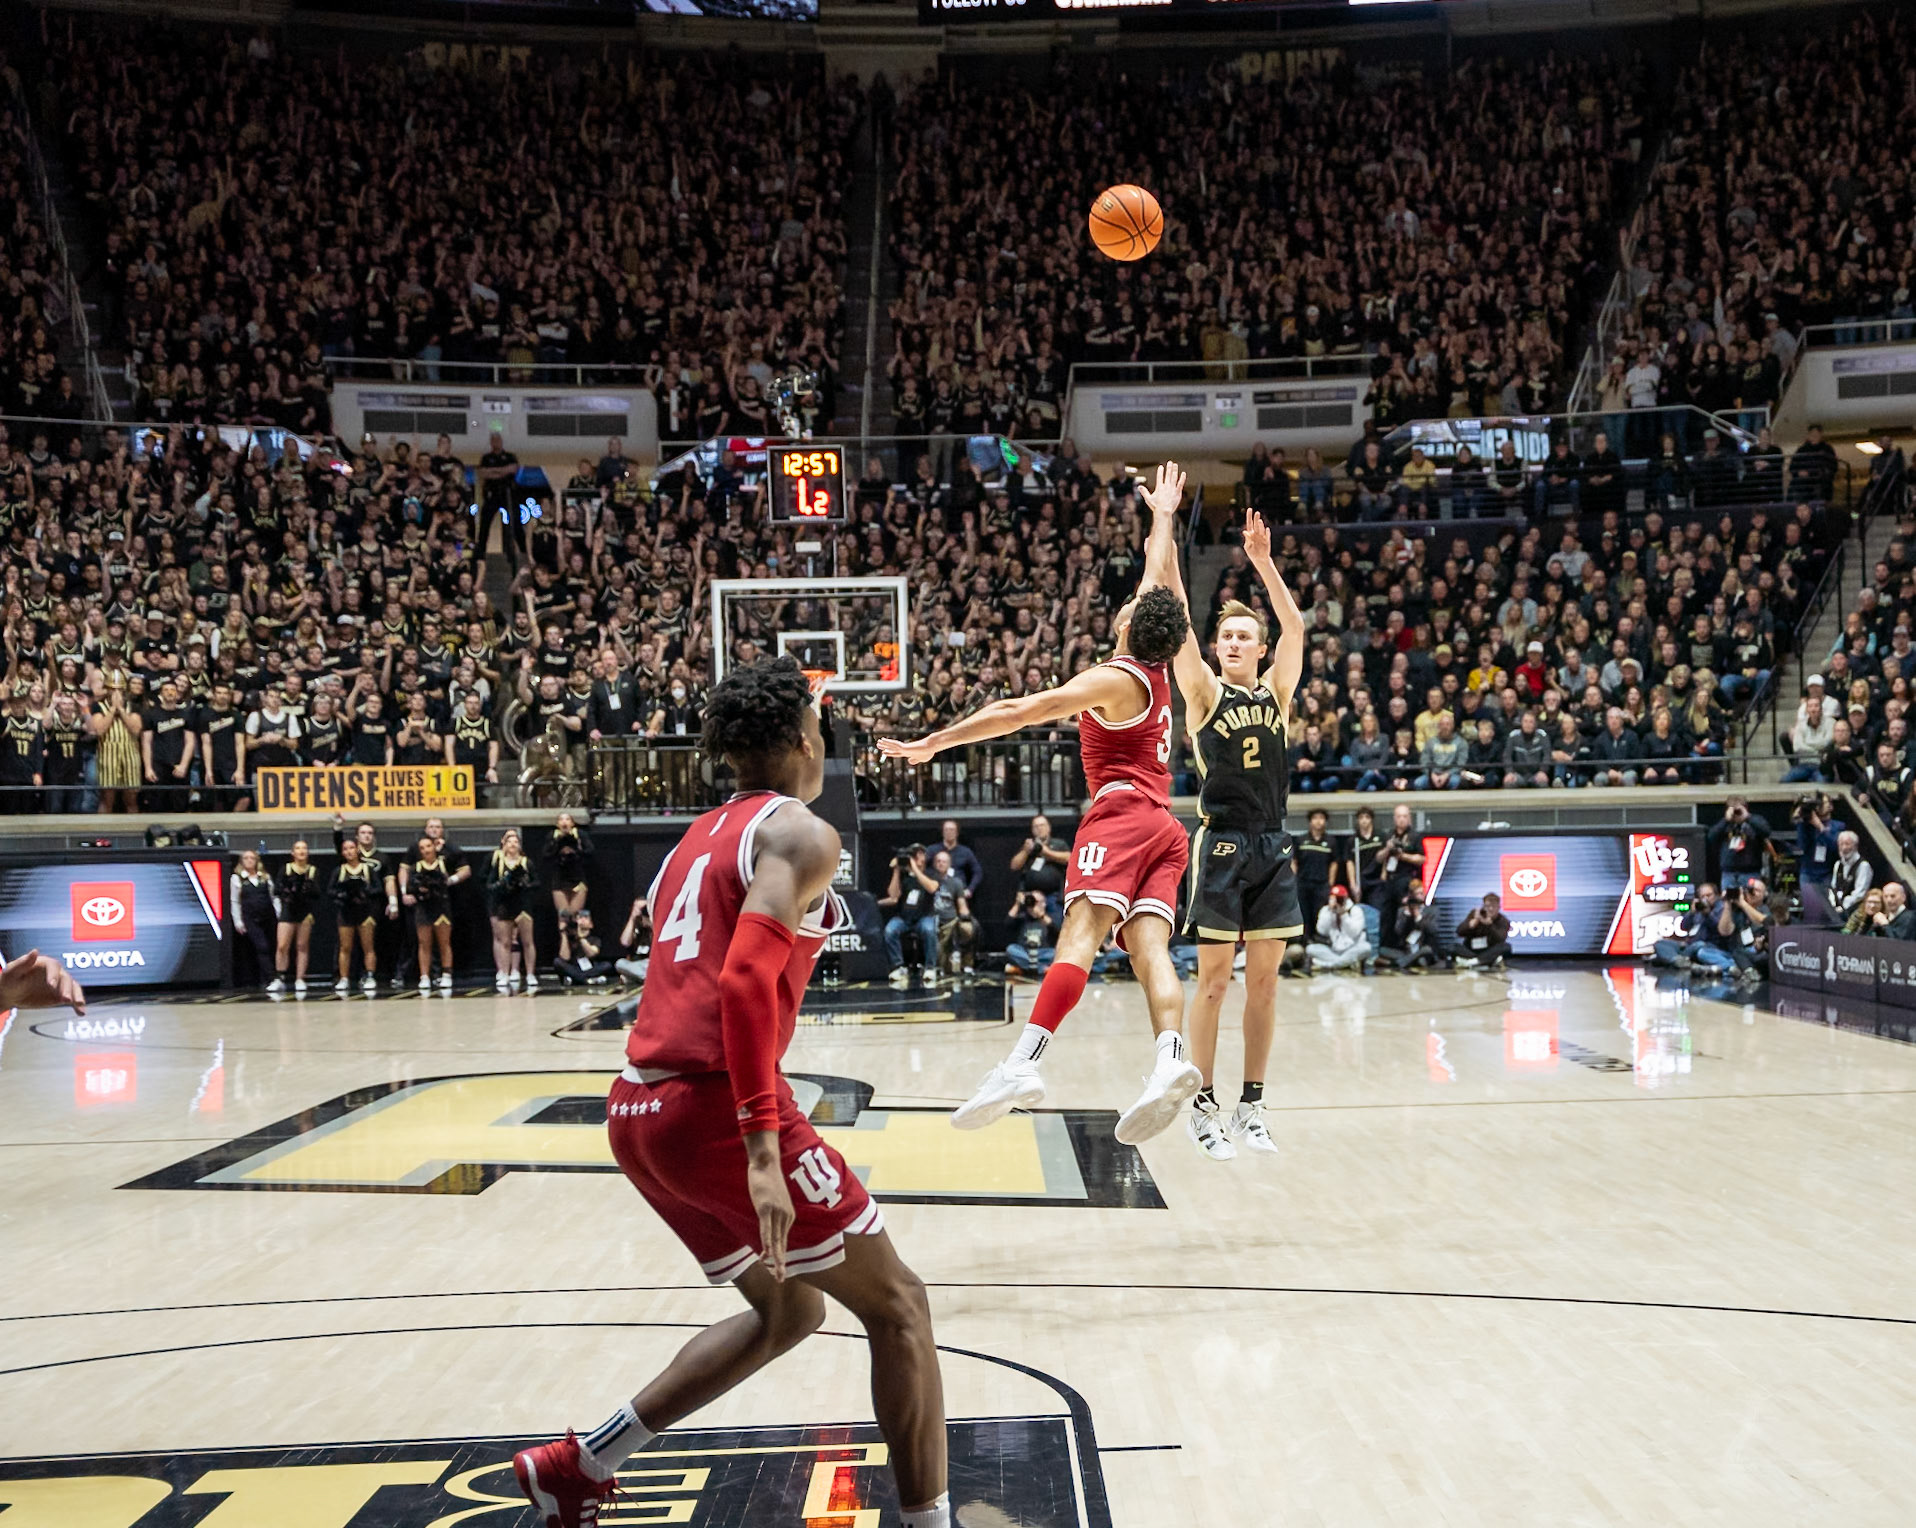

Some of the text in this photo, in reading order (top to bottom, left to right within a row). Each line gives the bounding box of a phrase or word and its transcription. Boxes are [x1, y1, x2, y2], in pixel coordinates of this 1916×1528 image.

[783, 452, 838, 477] 12:57
[797, 477, 831, 516] 1.2
[1156, 704, 1173, 764] 3
[1213, 704, 1283, 740] PURDUE
[1242, 736, 1262, 769] 2
[262, 770, 381, 808] DEFENSE
[383, 770, 424, 787] LIVES
[384, 789, 426, 807] HERE
[1212, 842, 1237, 857] P
[658, 853, 711, 963] 4
[1646, 886, 1688, 901] 12:57
[1507, 920, 1566, 938] OYOTA
[62, 950, 146, 969] TOYOTA
[789, 1145, 842, 1209] IU
